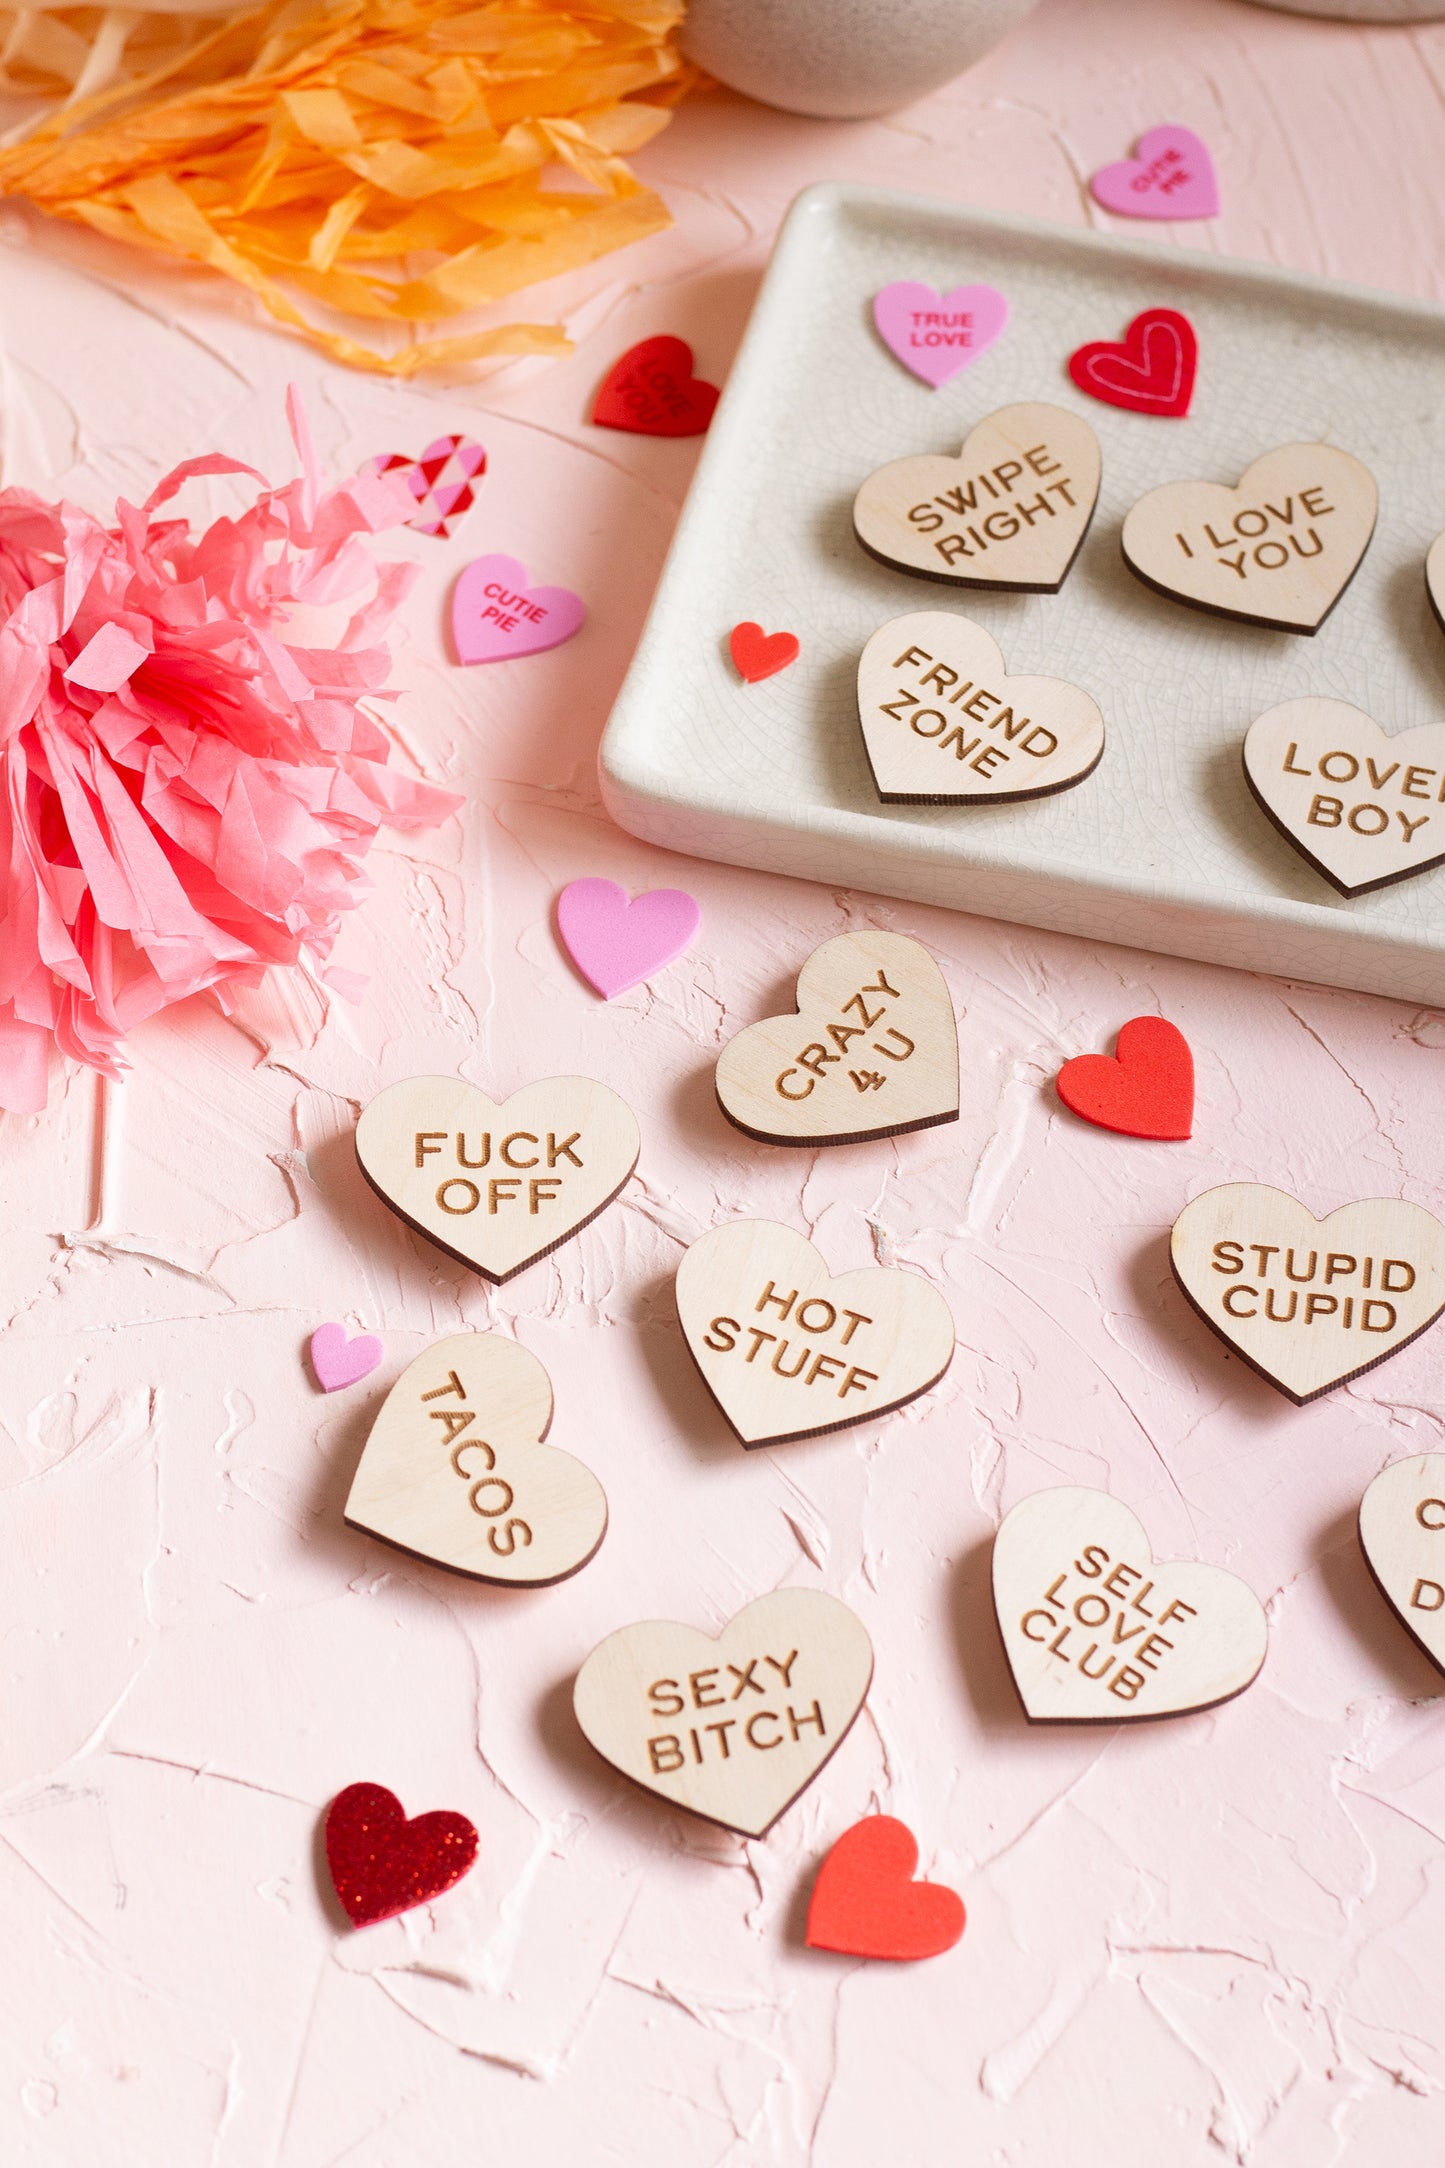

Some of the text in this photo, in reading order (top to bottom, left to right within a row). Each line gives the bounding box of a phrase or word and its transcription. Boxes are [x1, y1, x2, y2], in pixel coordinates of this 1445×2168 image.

[910, 311, 974, 328] TRUE
[910, 331, 973, 348] LOVE
[615, 377, 663, 424] YOU
[639, 360, 695, 418] LOVE
[907, 444, 1062, 533] SWIPE
[934, 478, 1077, 566] RIGHT
[1175, 486, 1335, 559] I LOVE
[1217, 528, 1324, 579] YOU
[481, 605, 520, 633] PIE
[482, 583, 549, 624] CUTIE
[878, 688, 1011, 779] ZONE
[892, 645, 1059, 758] FRIEND
[1282, 742, 1445, 803] LOVE
[1306, 793, 1430, 843] BOY
[775, 969, 900, 1101] CRAZY
[848, 1027, 915, 1093] 4 U
[415, 1131, 584, 1169] FUCK
[435, 1178, 562, 1215] OFF
[1211, 1240, 1416, 1293] STUPID
[754, 1280, 873, 1346] HOT
[1222, 1284, 1397, 1333] CUPID
[702, 1316, 879, 1398] STUFF
[420, 1370, 532, 1556] TACOS
[1073, 1545, 1198, 1625] SELF
[1020, 1609, 1146, 1700] CLUB
[1043, 1573, 1175, 1670] LOVE
[647, 1648, 799, 1717] SEXY
[646, 1699, 826, 1774] BITCH
